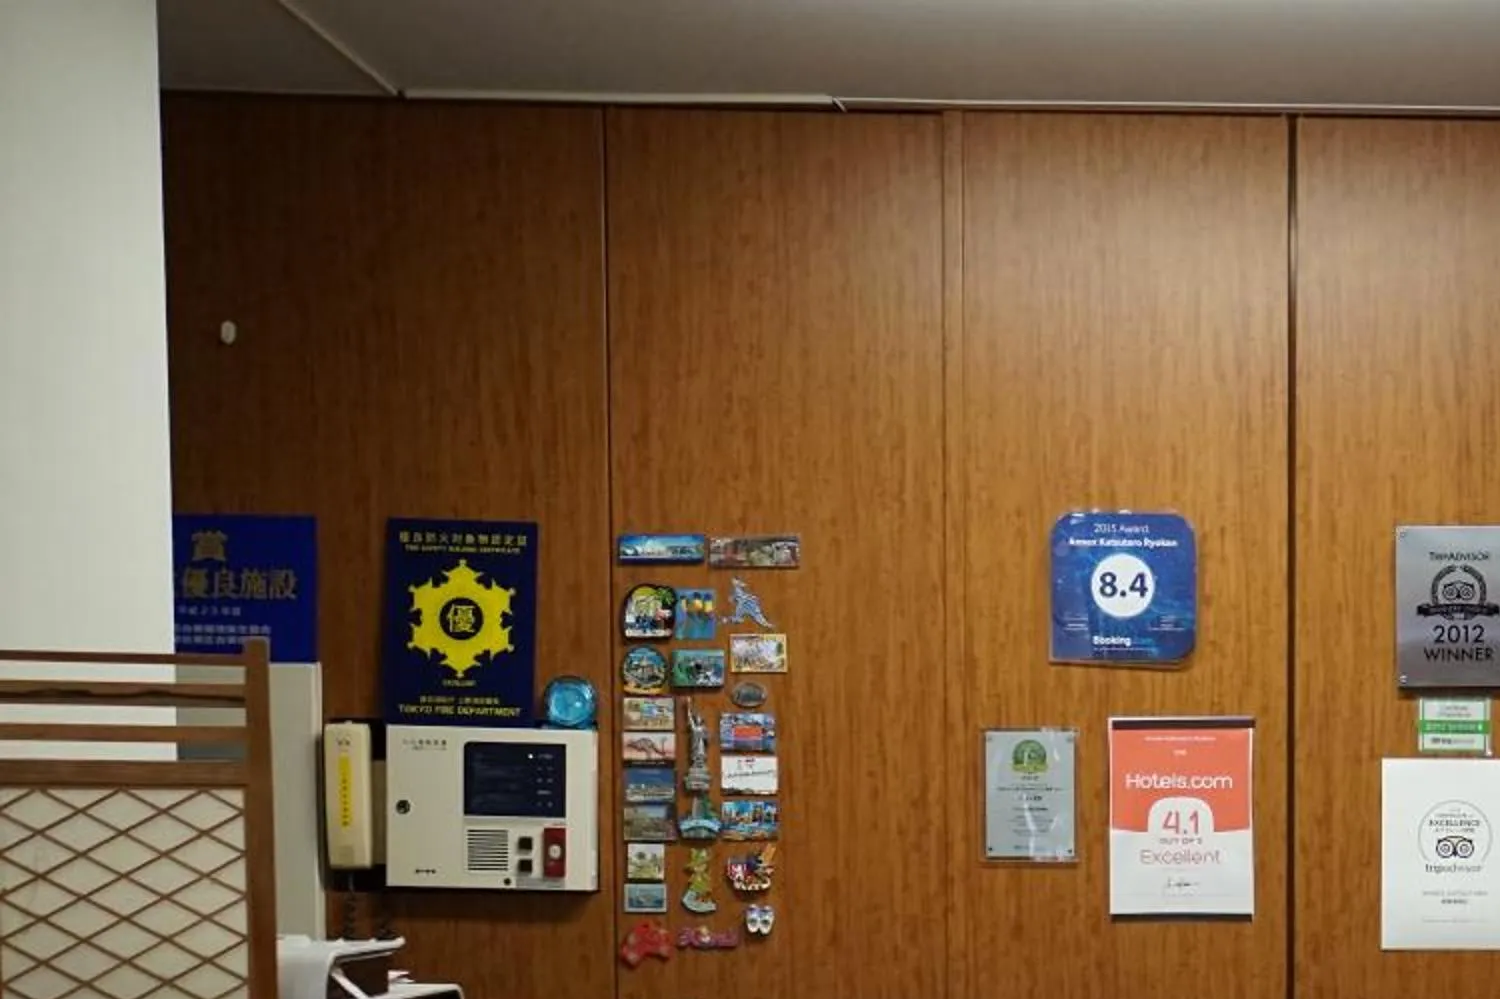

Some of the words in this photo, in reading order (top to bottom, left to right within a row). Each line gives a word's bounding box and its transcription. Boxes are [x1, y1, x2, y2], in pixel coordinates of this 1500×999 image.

[1119, 524, 1149, 534] Award
[1099, 571, 1149, 598] 8.4
[1433, 625, 1485, 644] 2012
[1424, 648, 1494, 662] WINNER
[1126, 773, 1233, 789] Hotels.com
[1162, 810, 1200, 834] 4.1
[1139, 849, 1222, 866] Excellent
